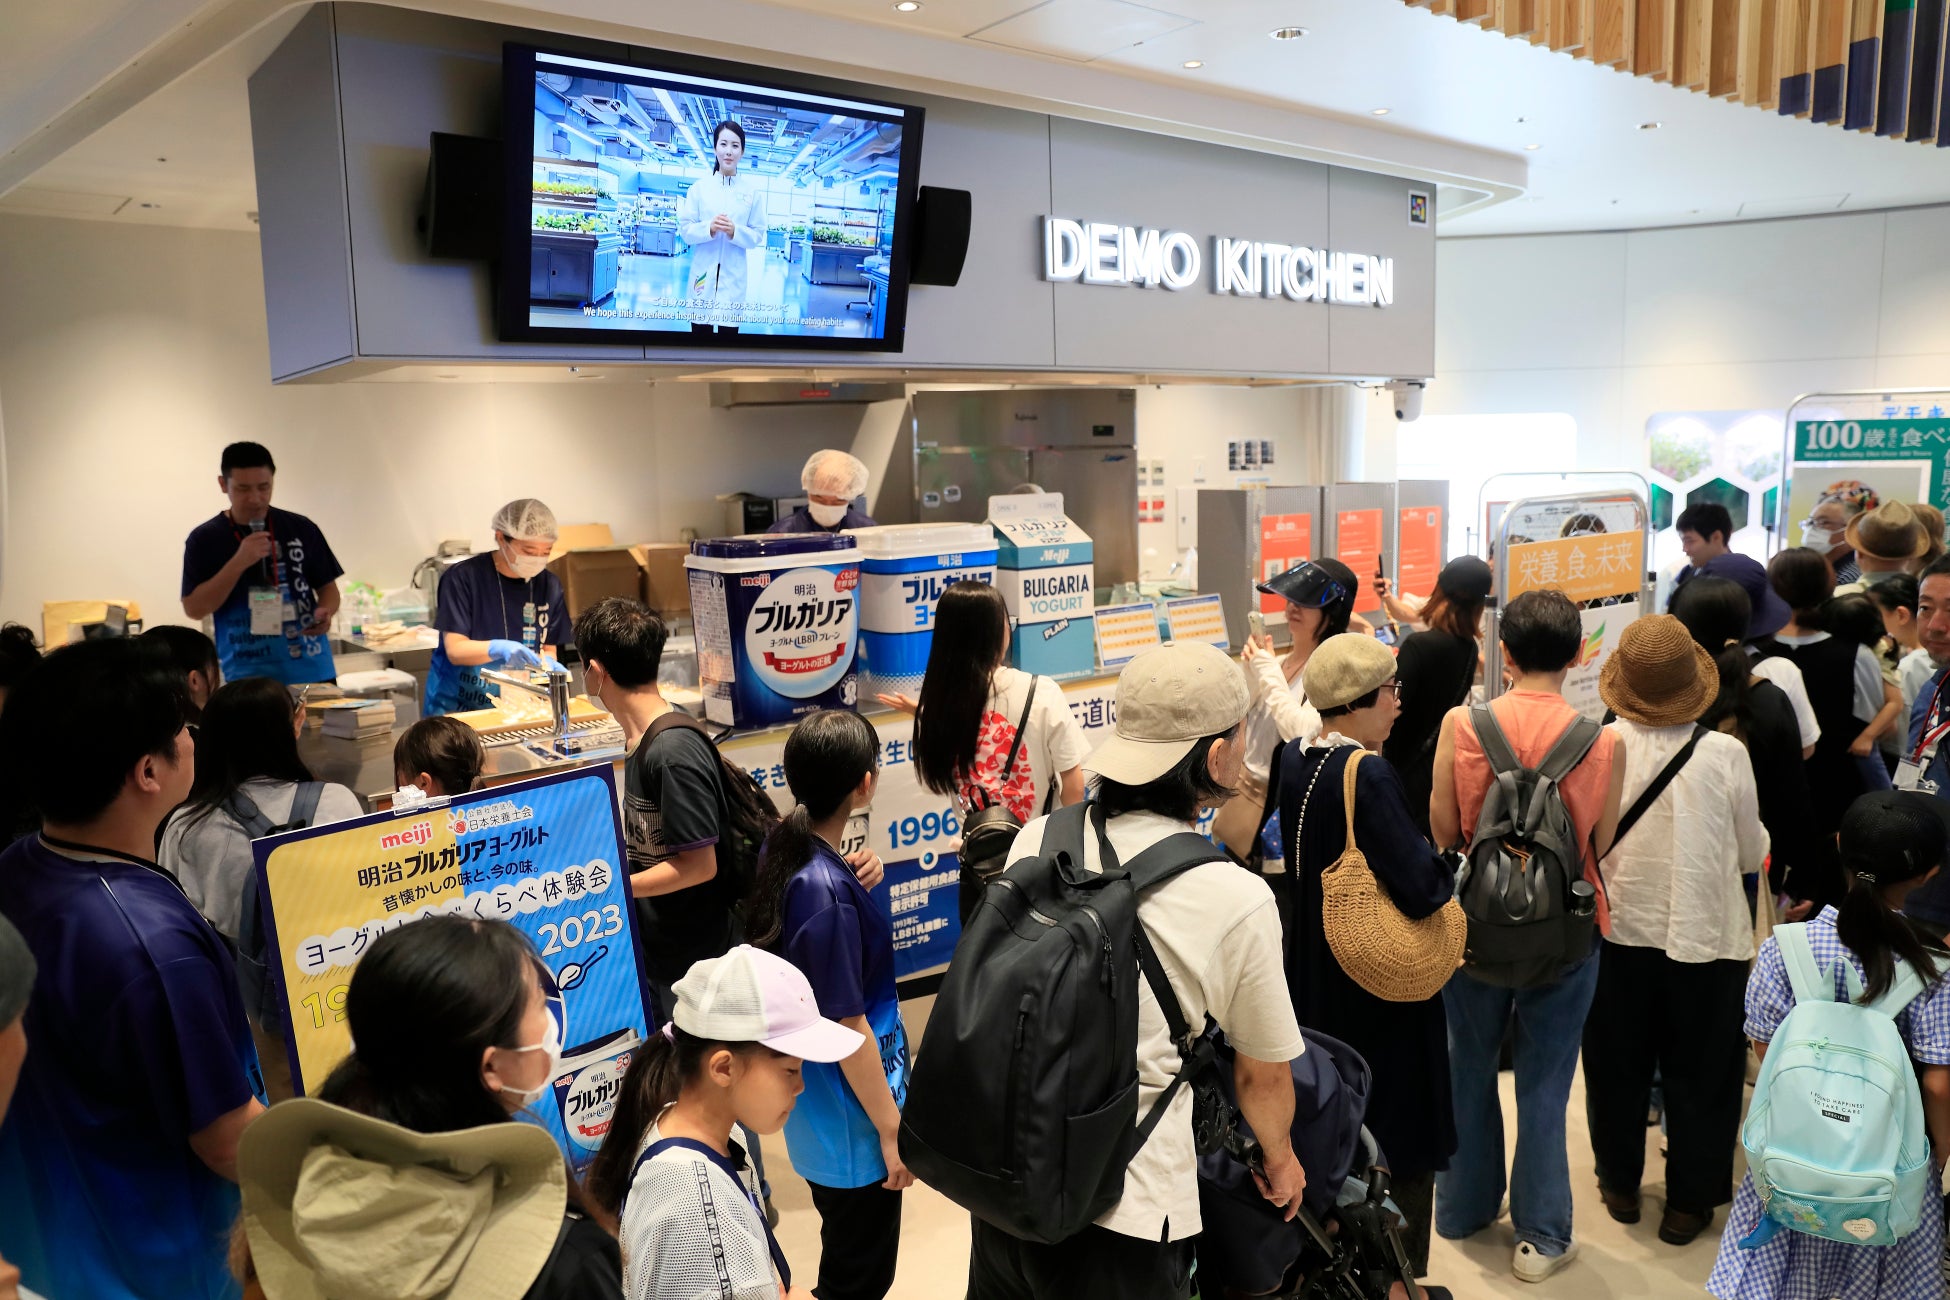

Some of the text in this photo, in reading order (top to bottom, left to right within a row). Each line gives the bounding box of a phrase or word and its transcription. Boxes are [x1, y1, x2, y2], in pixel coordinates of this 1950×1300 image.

[1044, 216, 1394, 306] DEMO KITCHEN
[583, 307, 596, 317] We
[597, 308, 617, 320] hope
[619, 309, 633, 318] this
[635, 310, 676, 322] experience
[676, 311, 706, 322] inspires
[706, 313, 719, 323] you
[722, 313, 729, 322] to
[730, 313, 747, 323] think
[748, 315, 768, 324] about
[769, 316, 785, 326] your
[801, 317, 821, 328] eating
[938, 554, 963, 566] 明治
[1040, 548, 1070, 564] Meiji
[1520, 540, 1633, 588] 栄養と食の未来
[740, 573, 771, 588] meiji
[794, 584, 816, 596] 明治
[1023, 574, 1090, 598] BULGARIA
[1030, 596, 1084, 614] YOGURT
[755, 598, 852, 634] ブルガリア
[797, 633, 816, 645] LB81
[819, 631, 841, 642] プレーン
[1044, 618, 1069, 639] PLAIN
[780, 655, 832, 671] ヨーグルトの正統
[469, 807, 532, 832] 日本栄養士会
[888, 808, 961, 850] 1996
[382, 822, 433, 850] meiji
[382, 859, 539, 913] 昔懐かしの味と、今の味。
[537, 904, 623, 957] 2023
[892, 934, 931, 951] リニューアル
[554, 1074, 573, 1088] meiji
[568, 1078, 624, 1116] ブルガリ
[1822, 1102, 1838, 1110] TAKE
[1841, 1107, 1861, 1115] CARE
[1824, 1111, 1847, 1121] SPECIAL
